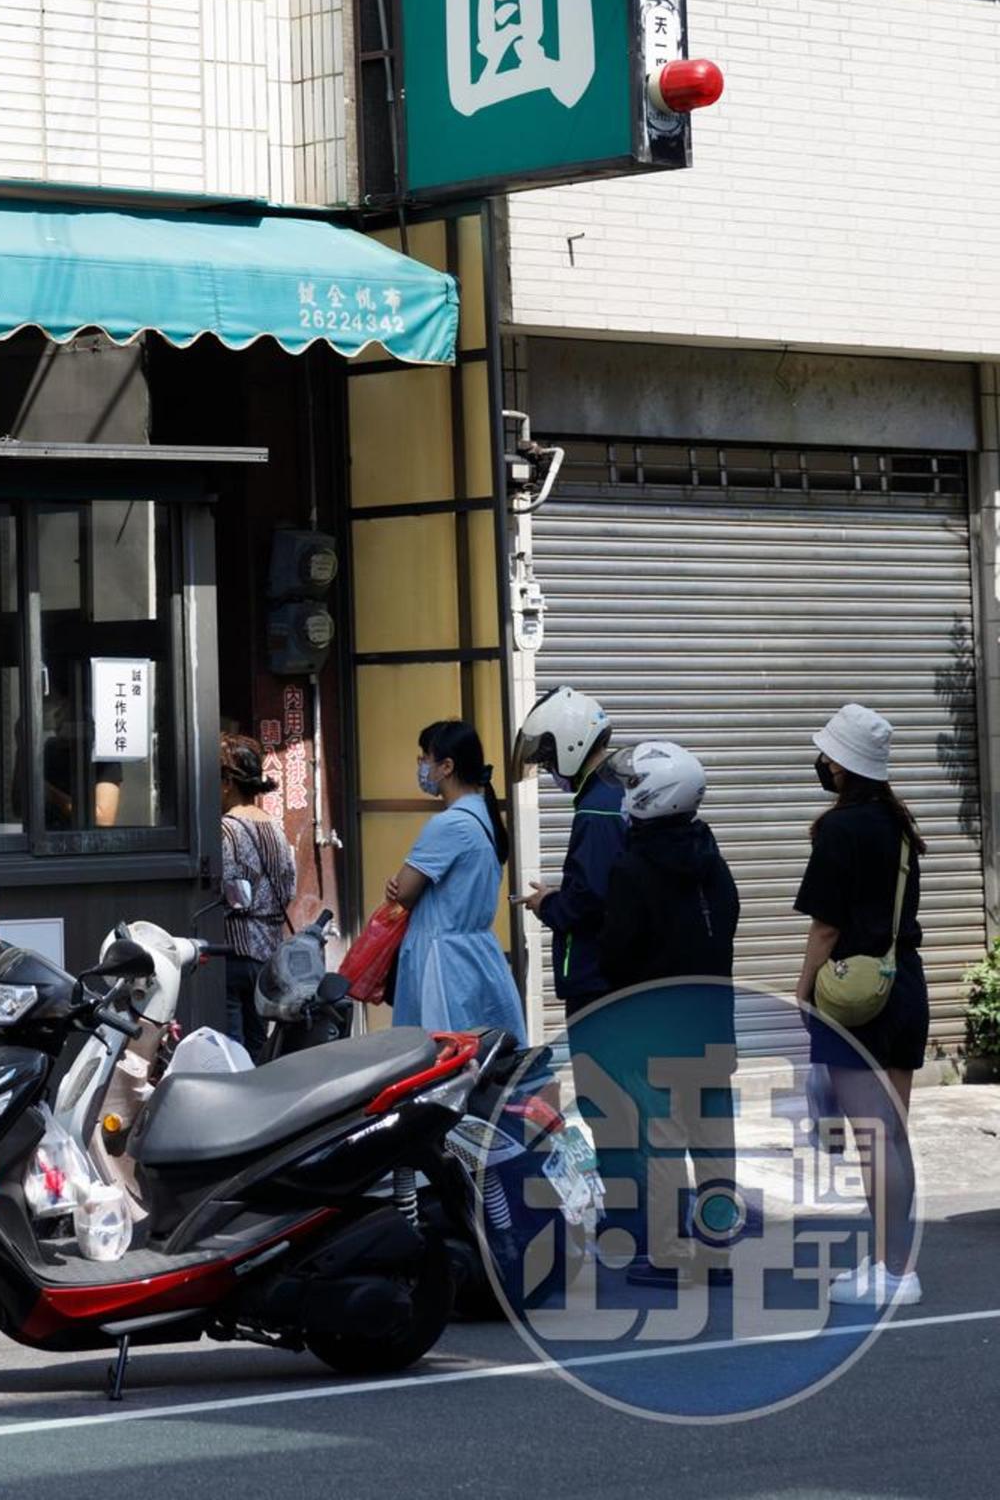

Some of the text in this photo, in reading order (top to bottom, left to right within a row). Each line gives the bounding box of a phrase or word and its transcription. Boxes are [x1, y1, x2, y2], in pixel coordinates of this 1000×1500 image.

[300, 309, 405, 333] 26224342
[114, 682, 127, 752] 工作伙伴
